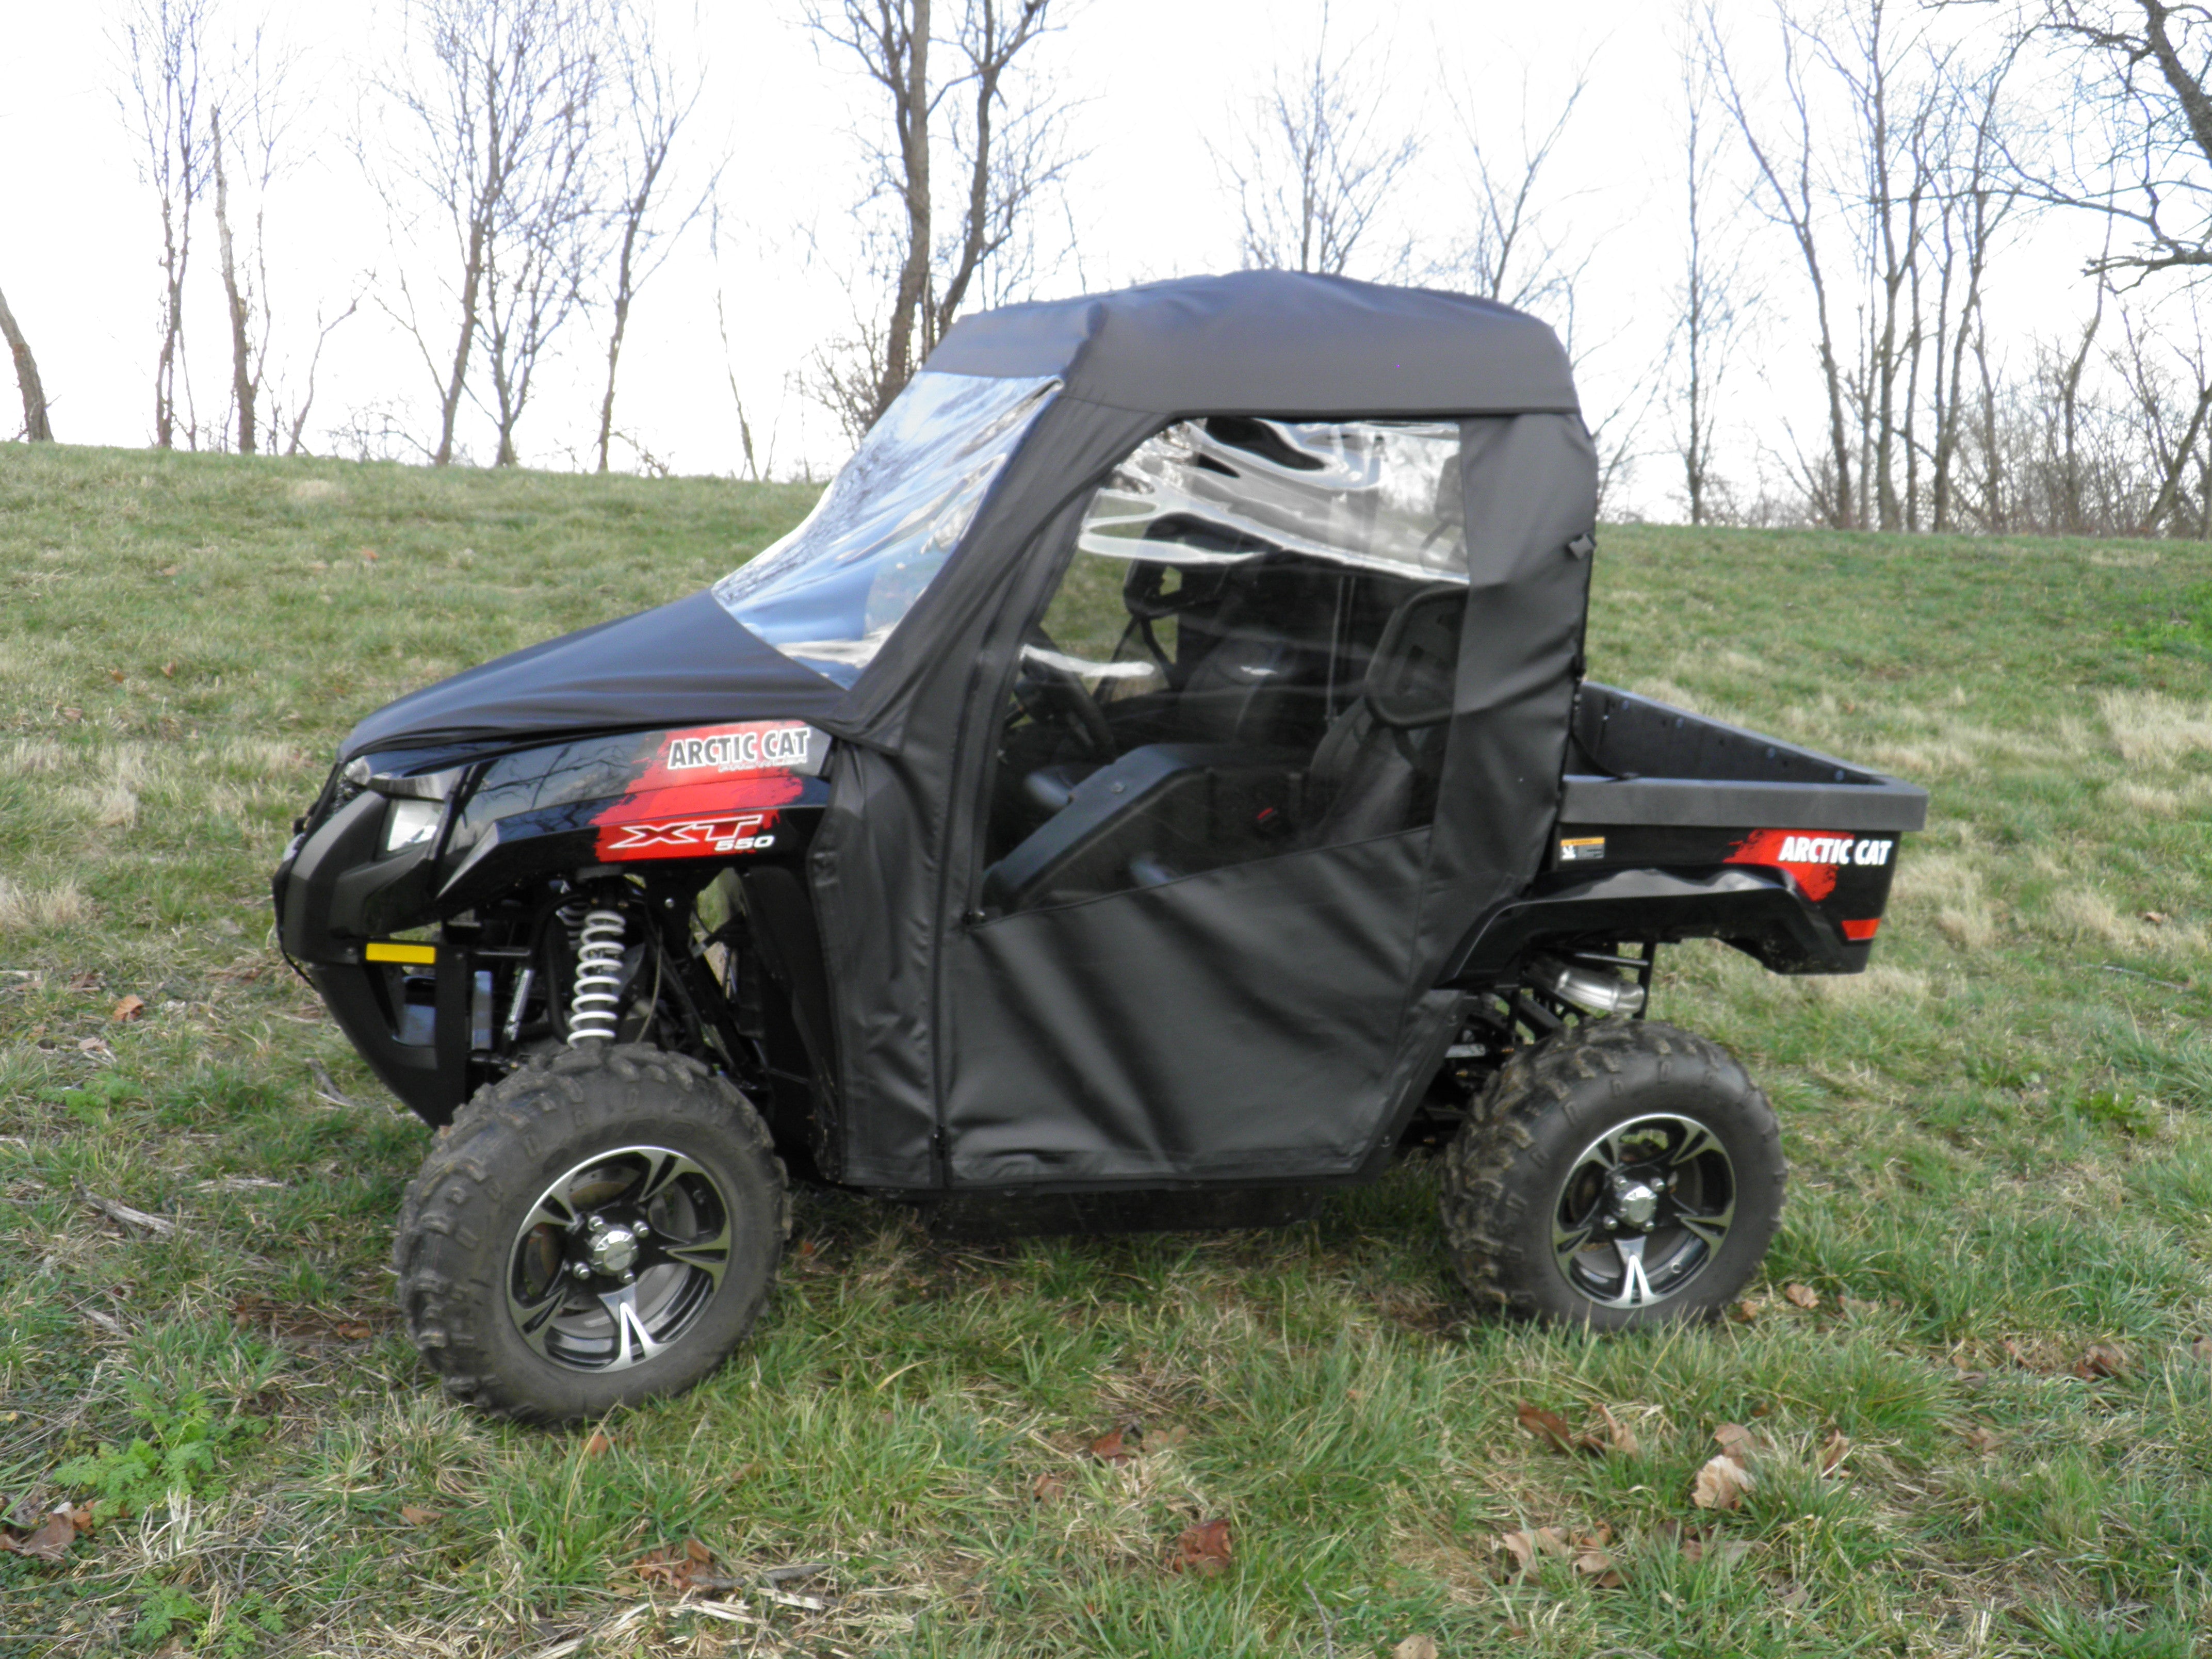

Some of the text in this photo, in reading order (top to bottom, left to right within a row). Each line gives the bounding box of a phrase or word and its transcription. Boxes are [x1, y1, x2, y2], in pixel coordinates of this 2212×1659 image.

[668, 733, 757, 769] ARCTIC
[761, 727, 810, 759] CAT
[608, 814, 763, 849] XT
[714, 835, 774, 851] 550
[1778, 836, 1893, 865] ARCTIC CAT
